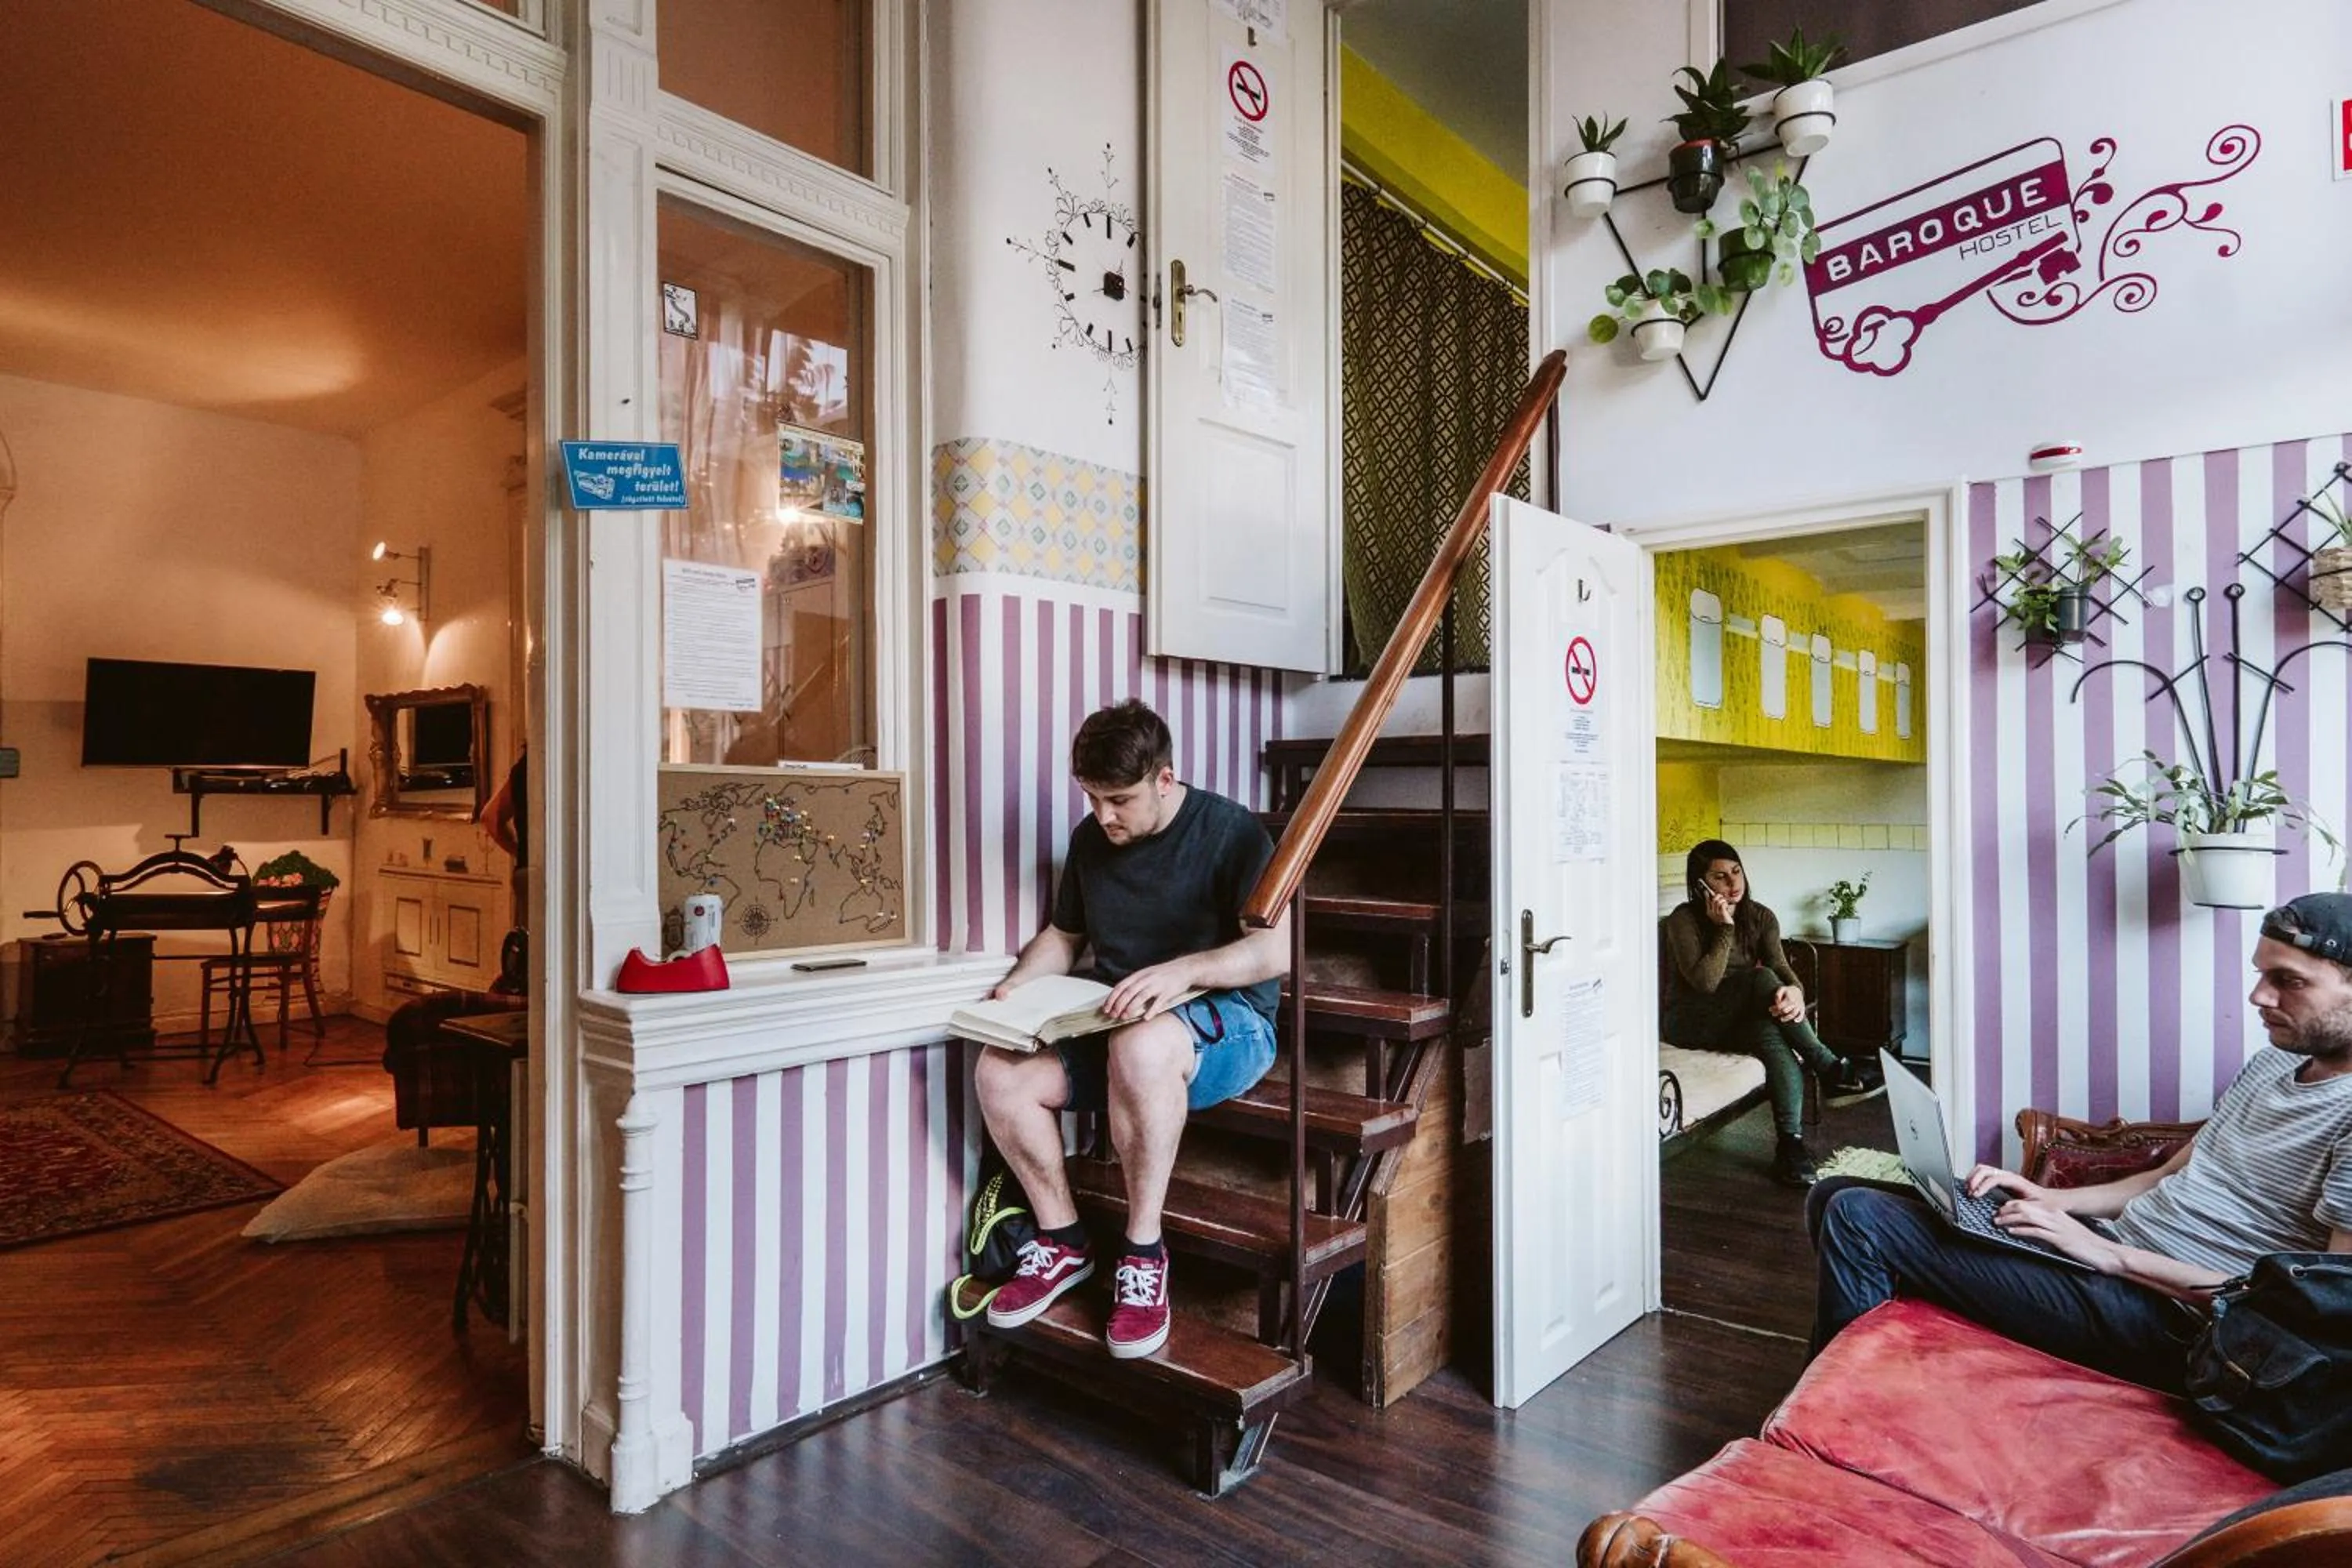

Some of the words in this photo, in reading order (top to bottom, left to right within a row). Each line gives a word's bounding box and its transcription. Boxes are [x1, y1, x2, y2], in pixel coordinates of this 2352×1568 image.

[1827, 177, 2046, 281] BAROQUE
[1959, 214, 2063, 260] HOSTEL
[578, 448, 645, 461] Kamerával
[606, 463, 671, 478] megfigyelt
[634, 480, 680, 492] terület!
